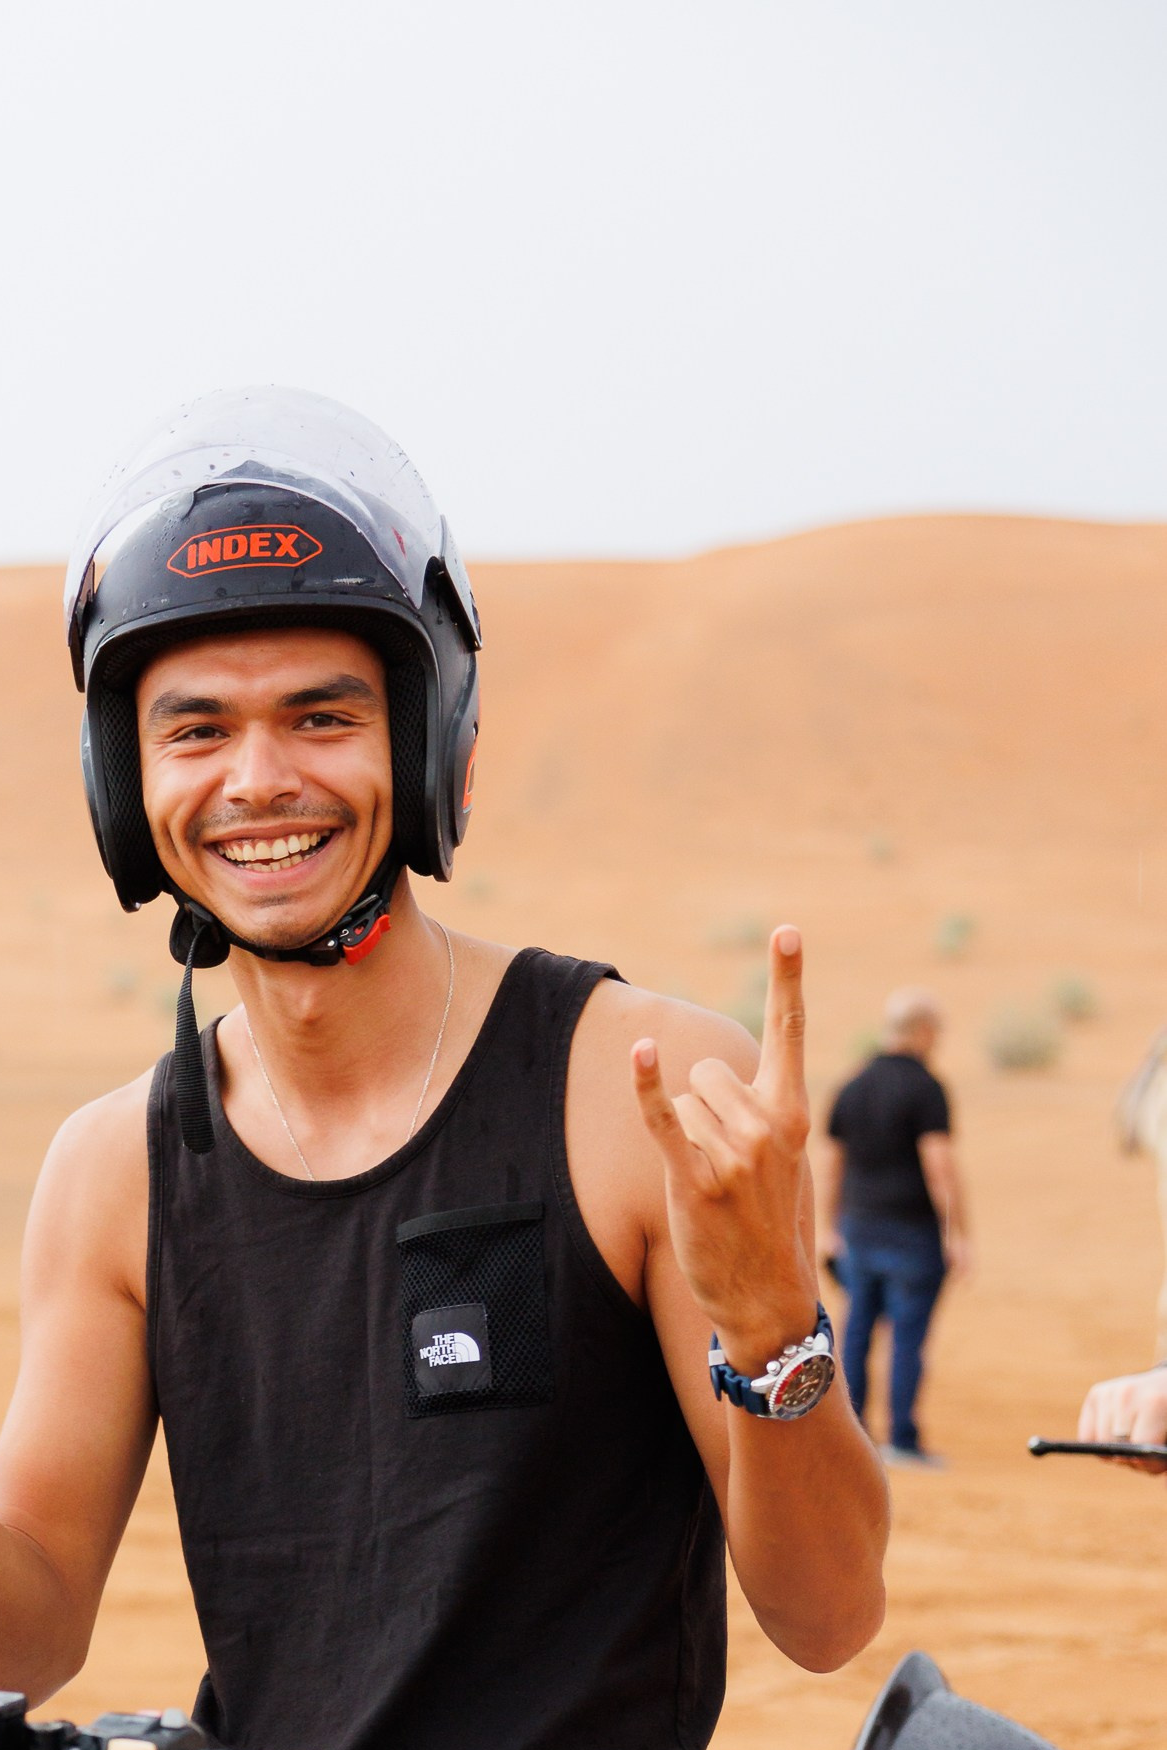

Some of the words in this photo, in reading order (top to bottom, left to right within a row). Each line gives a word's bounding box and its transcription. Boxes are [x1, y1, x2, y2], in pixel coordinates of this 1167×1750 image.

[187, 532, 300, 570] INDEX
[432, 1333, 454, 1345] THE
[419, 1344, 455, 1360] NORTH
[429, 1355, 456, 1367] FACE
